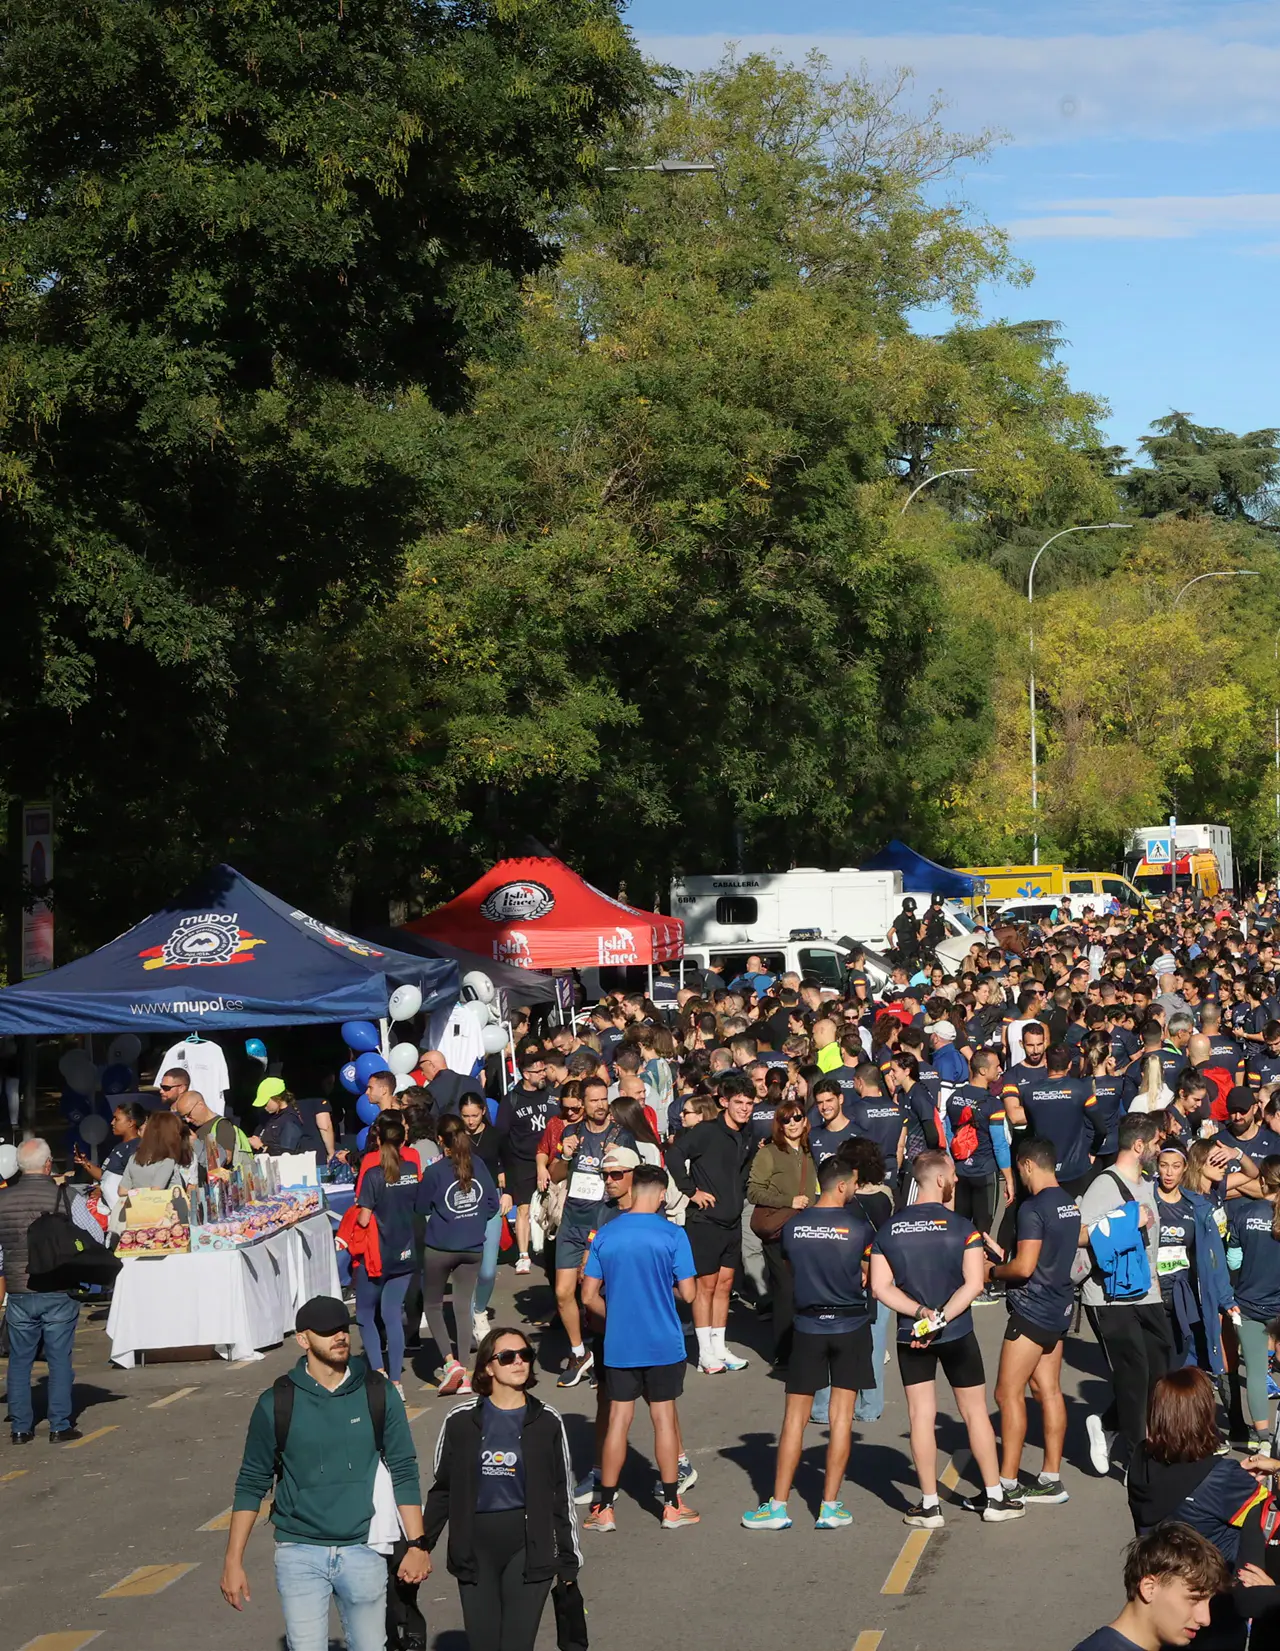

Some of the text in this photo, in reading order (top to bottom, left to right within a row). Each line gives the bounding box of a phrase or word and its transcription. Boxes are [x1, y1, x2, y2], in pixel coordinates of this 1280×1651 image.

[504, 891, 528, 901] Isla
[502, 898, 536, 908] Race
[180, 913, 238, 927] mupol
[492, 940, 521, 955] Isla
[597, 936, 627, 950] Isla
[598, 949, 638, 965] Race
[130, 997, 244, 1016] www.mupol.es
[516, 1107, 533, 1118] NEW
[891, 1221, 935, 1229] POLICIA
[891, 1225, 947, 1235] NACIONAL
[1160, 1226, 1185, 1236] 200
[481, 1450, 517, 1466] 200
